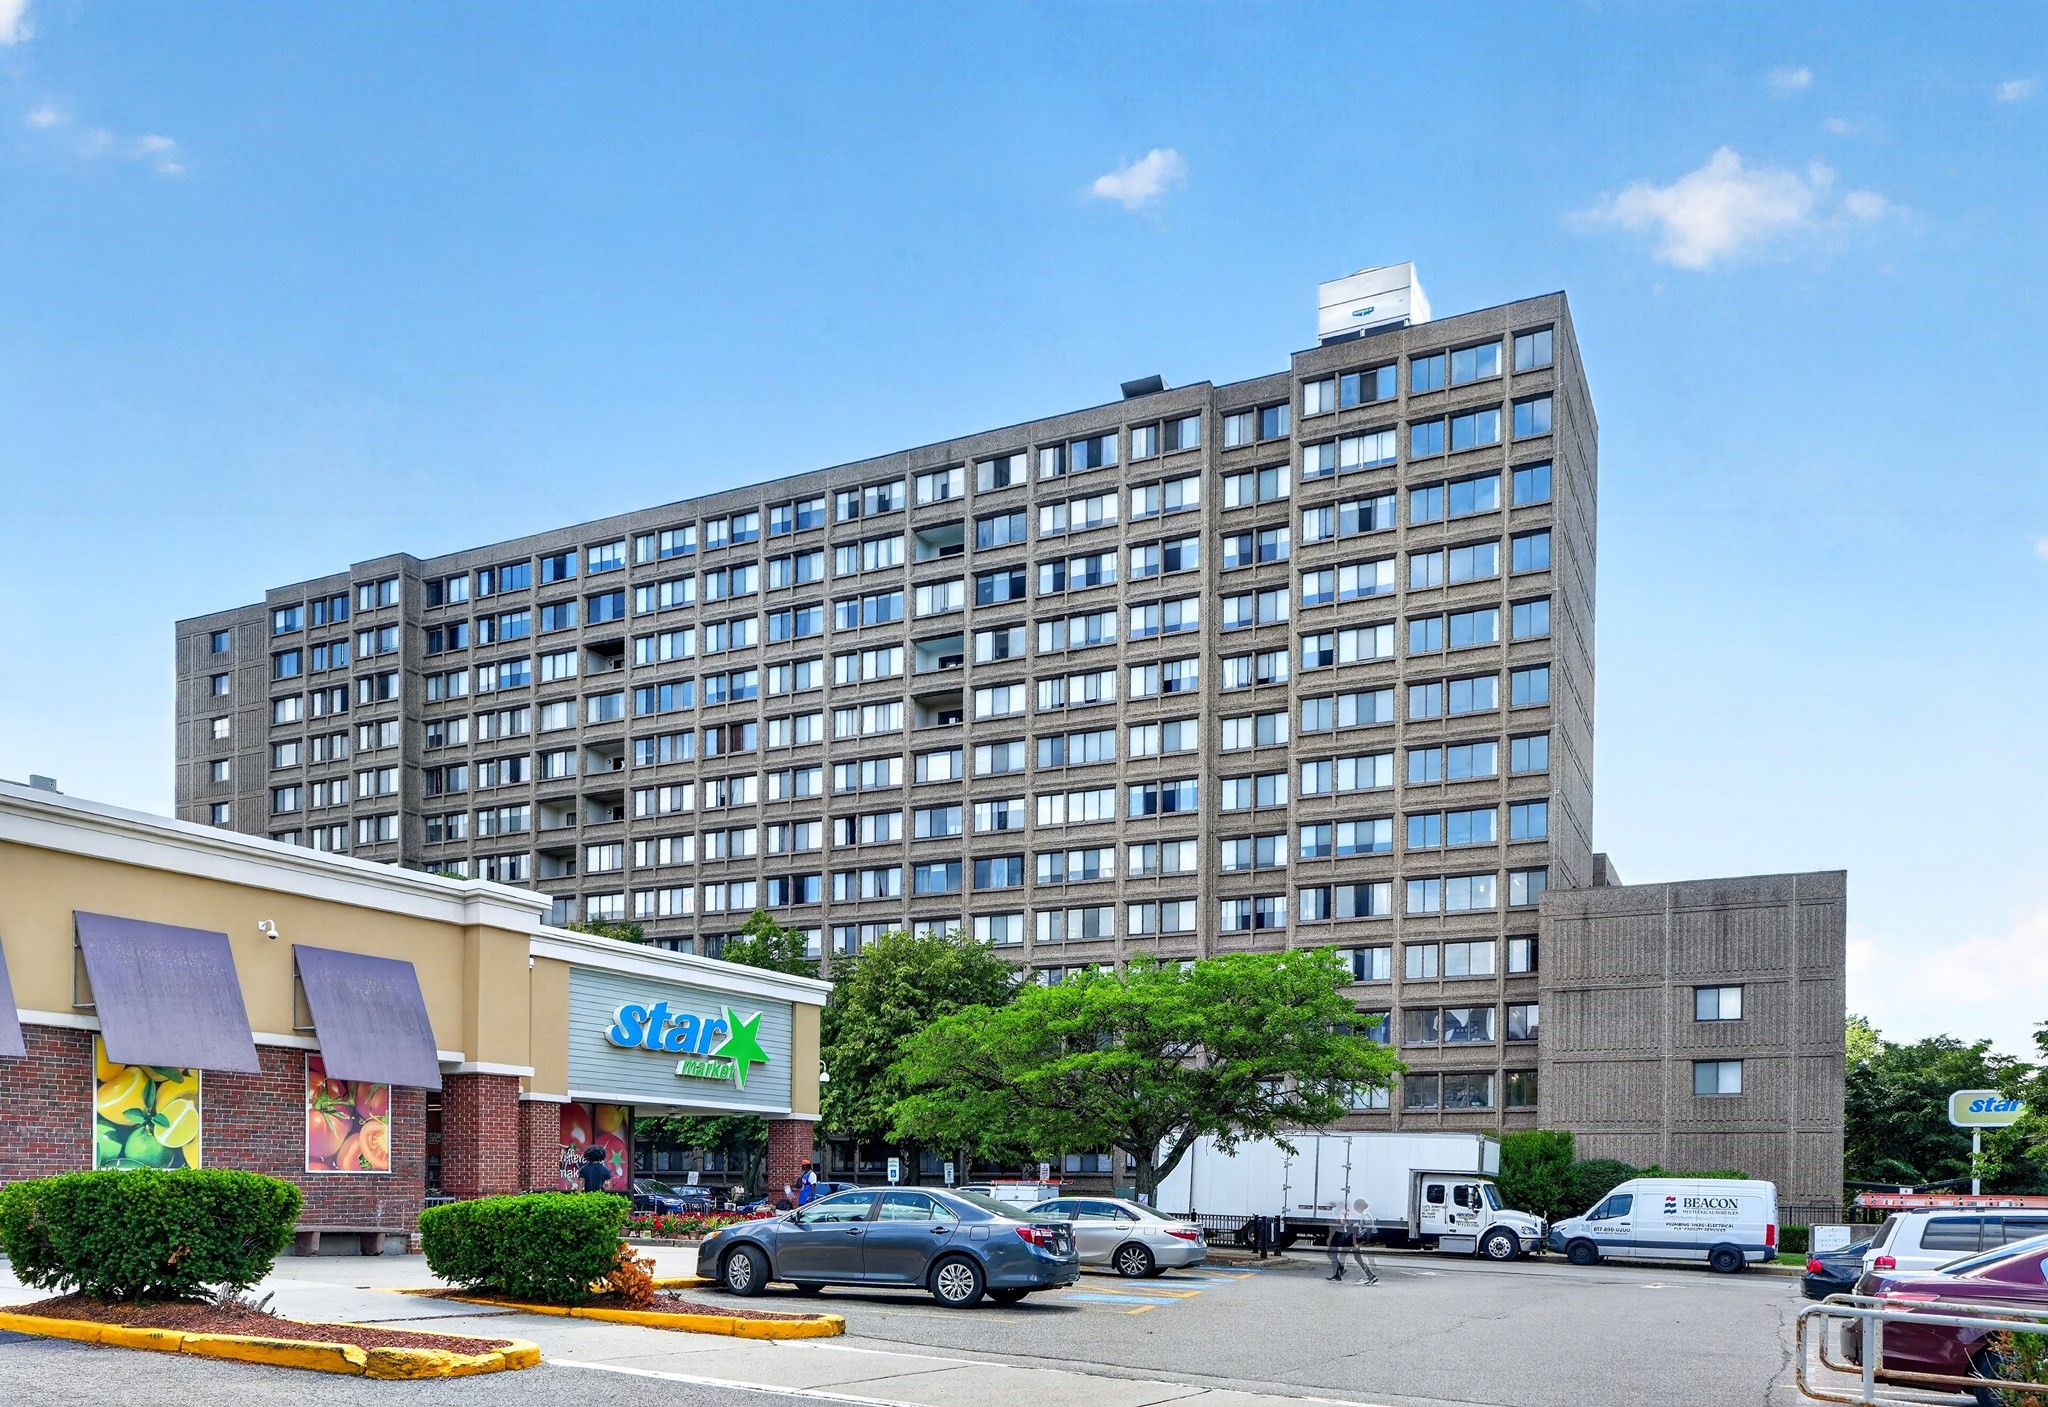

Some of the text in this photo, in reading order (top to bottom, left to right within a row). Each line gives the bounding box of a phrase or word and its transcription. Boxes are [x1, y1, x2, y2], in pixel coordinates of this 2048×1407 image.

[605, 1001, 728, 1054] star
[681, 1060, 735, 1080] market
[1968, 1096, 2025, 1113] star
[1683, 1197, 1738, 1209] BEACON
